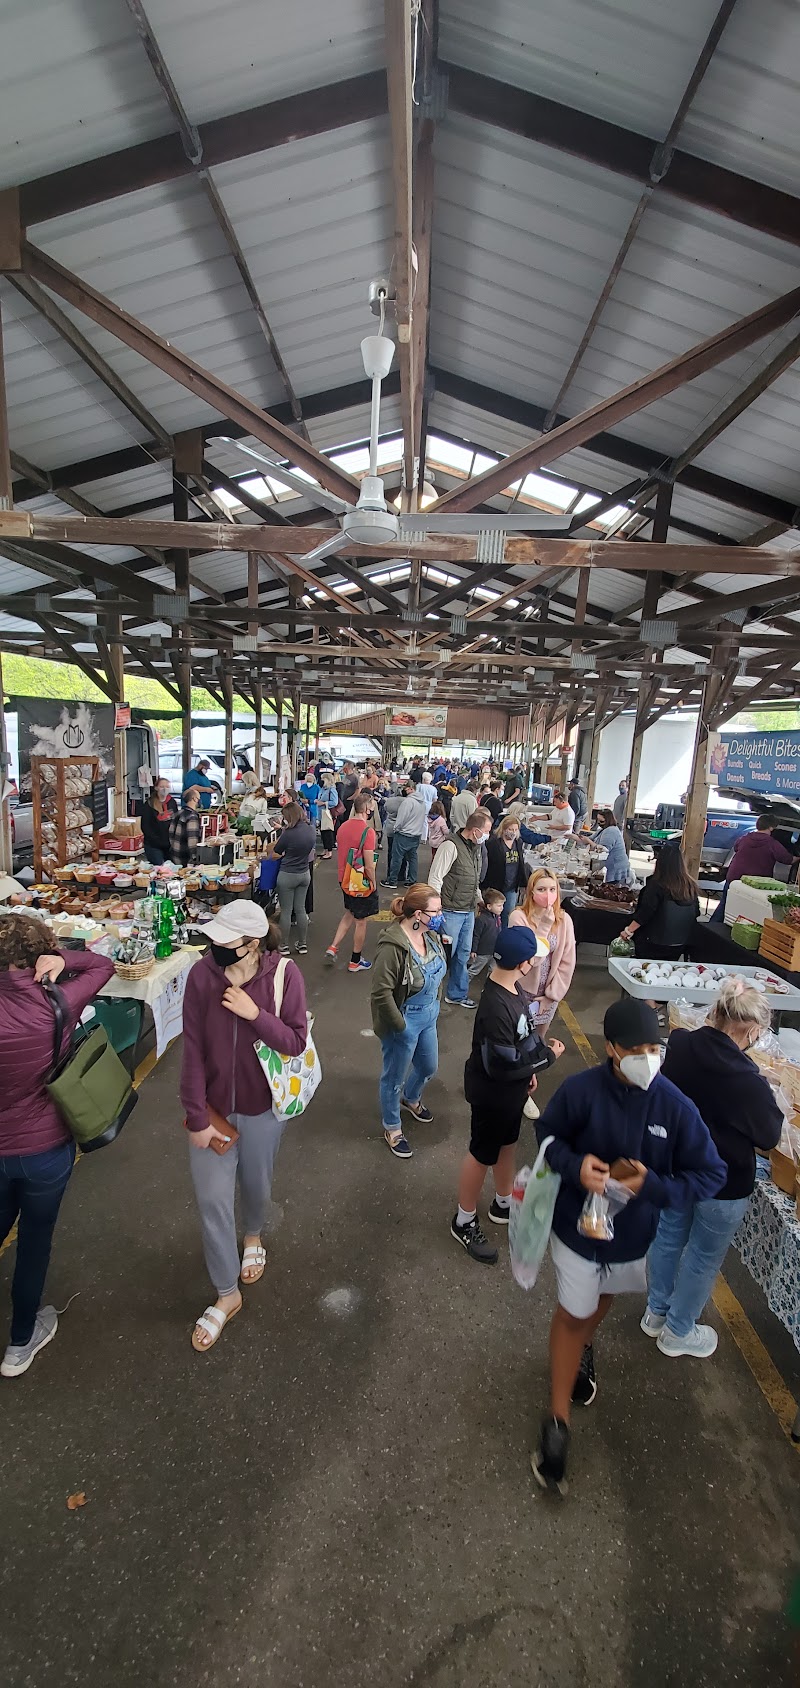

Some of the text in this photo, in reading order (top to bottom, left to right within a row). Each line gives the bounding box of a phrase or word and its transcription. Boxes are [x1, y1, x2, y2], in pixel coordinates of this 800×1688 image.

[730, 739, 800, 760] Delightful Bites
[748, 761, 762, 769] Quick
[774, 761, 797, 772] Scones
[726, 773, 744, 783] Donuts
[751, 771, 771, 781] Breads
[782, 778, 800, 789] More
